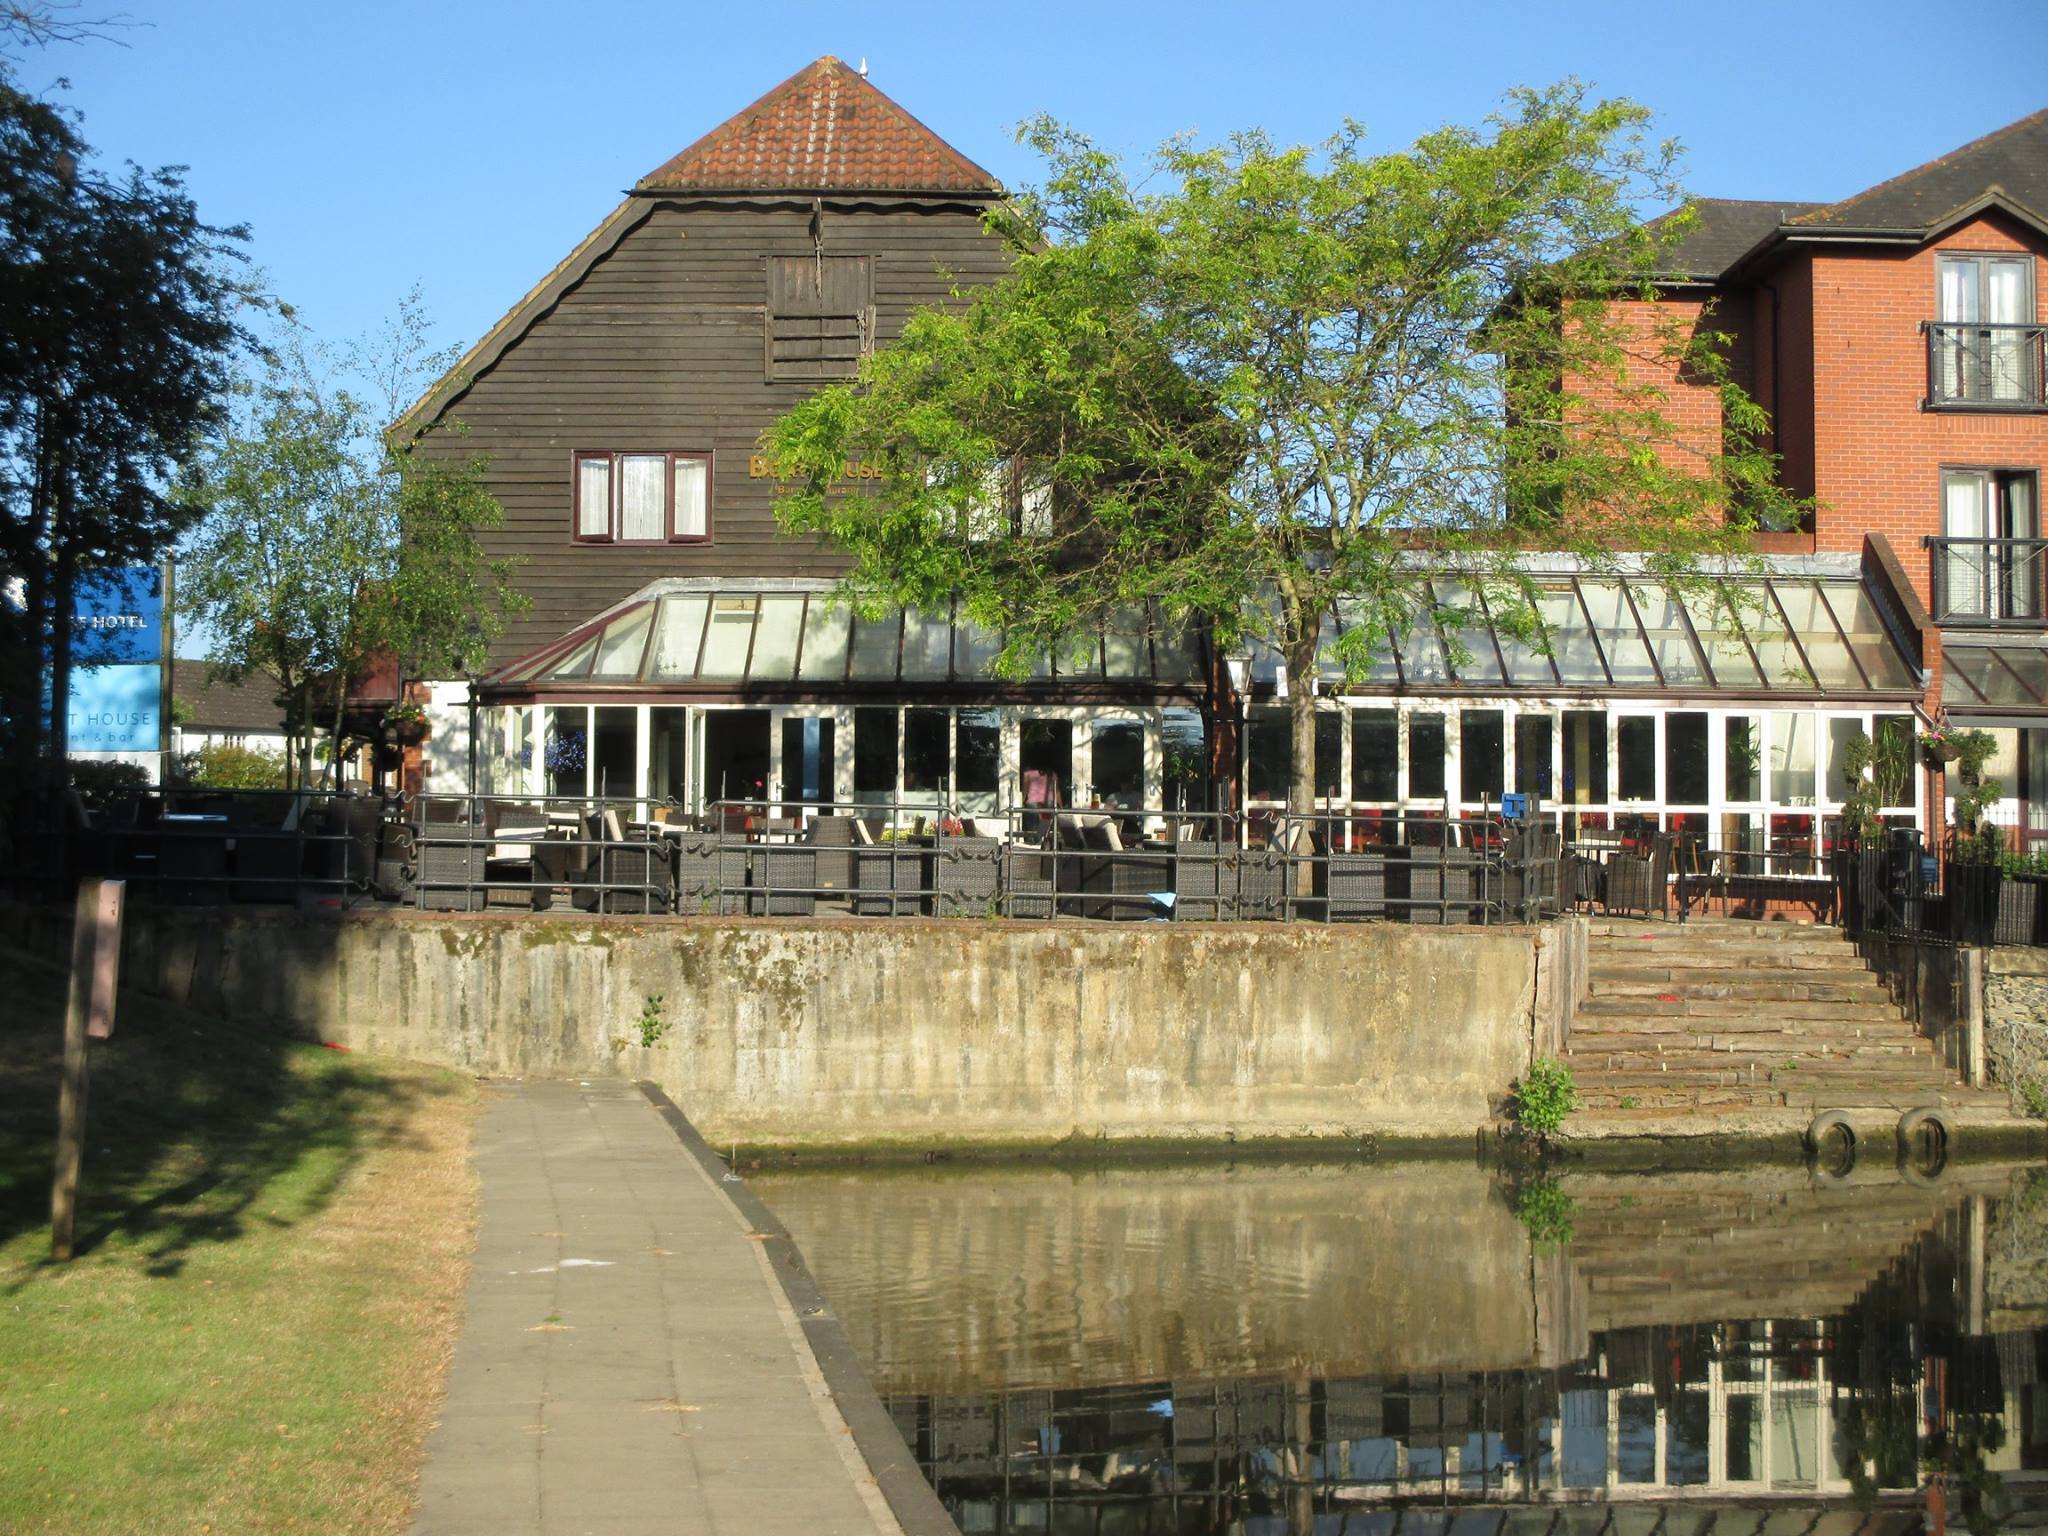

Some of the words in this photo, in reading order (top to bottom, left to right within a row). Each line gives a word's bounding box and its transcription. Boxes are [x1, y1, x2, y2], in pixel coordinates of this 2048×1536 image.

[94, 615, 148, 628] HOTEL
[88, 713, 150, 726] HOUSE
[108, 732, 134, 742] bar
